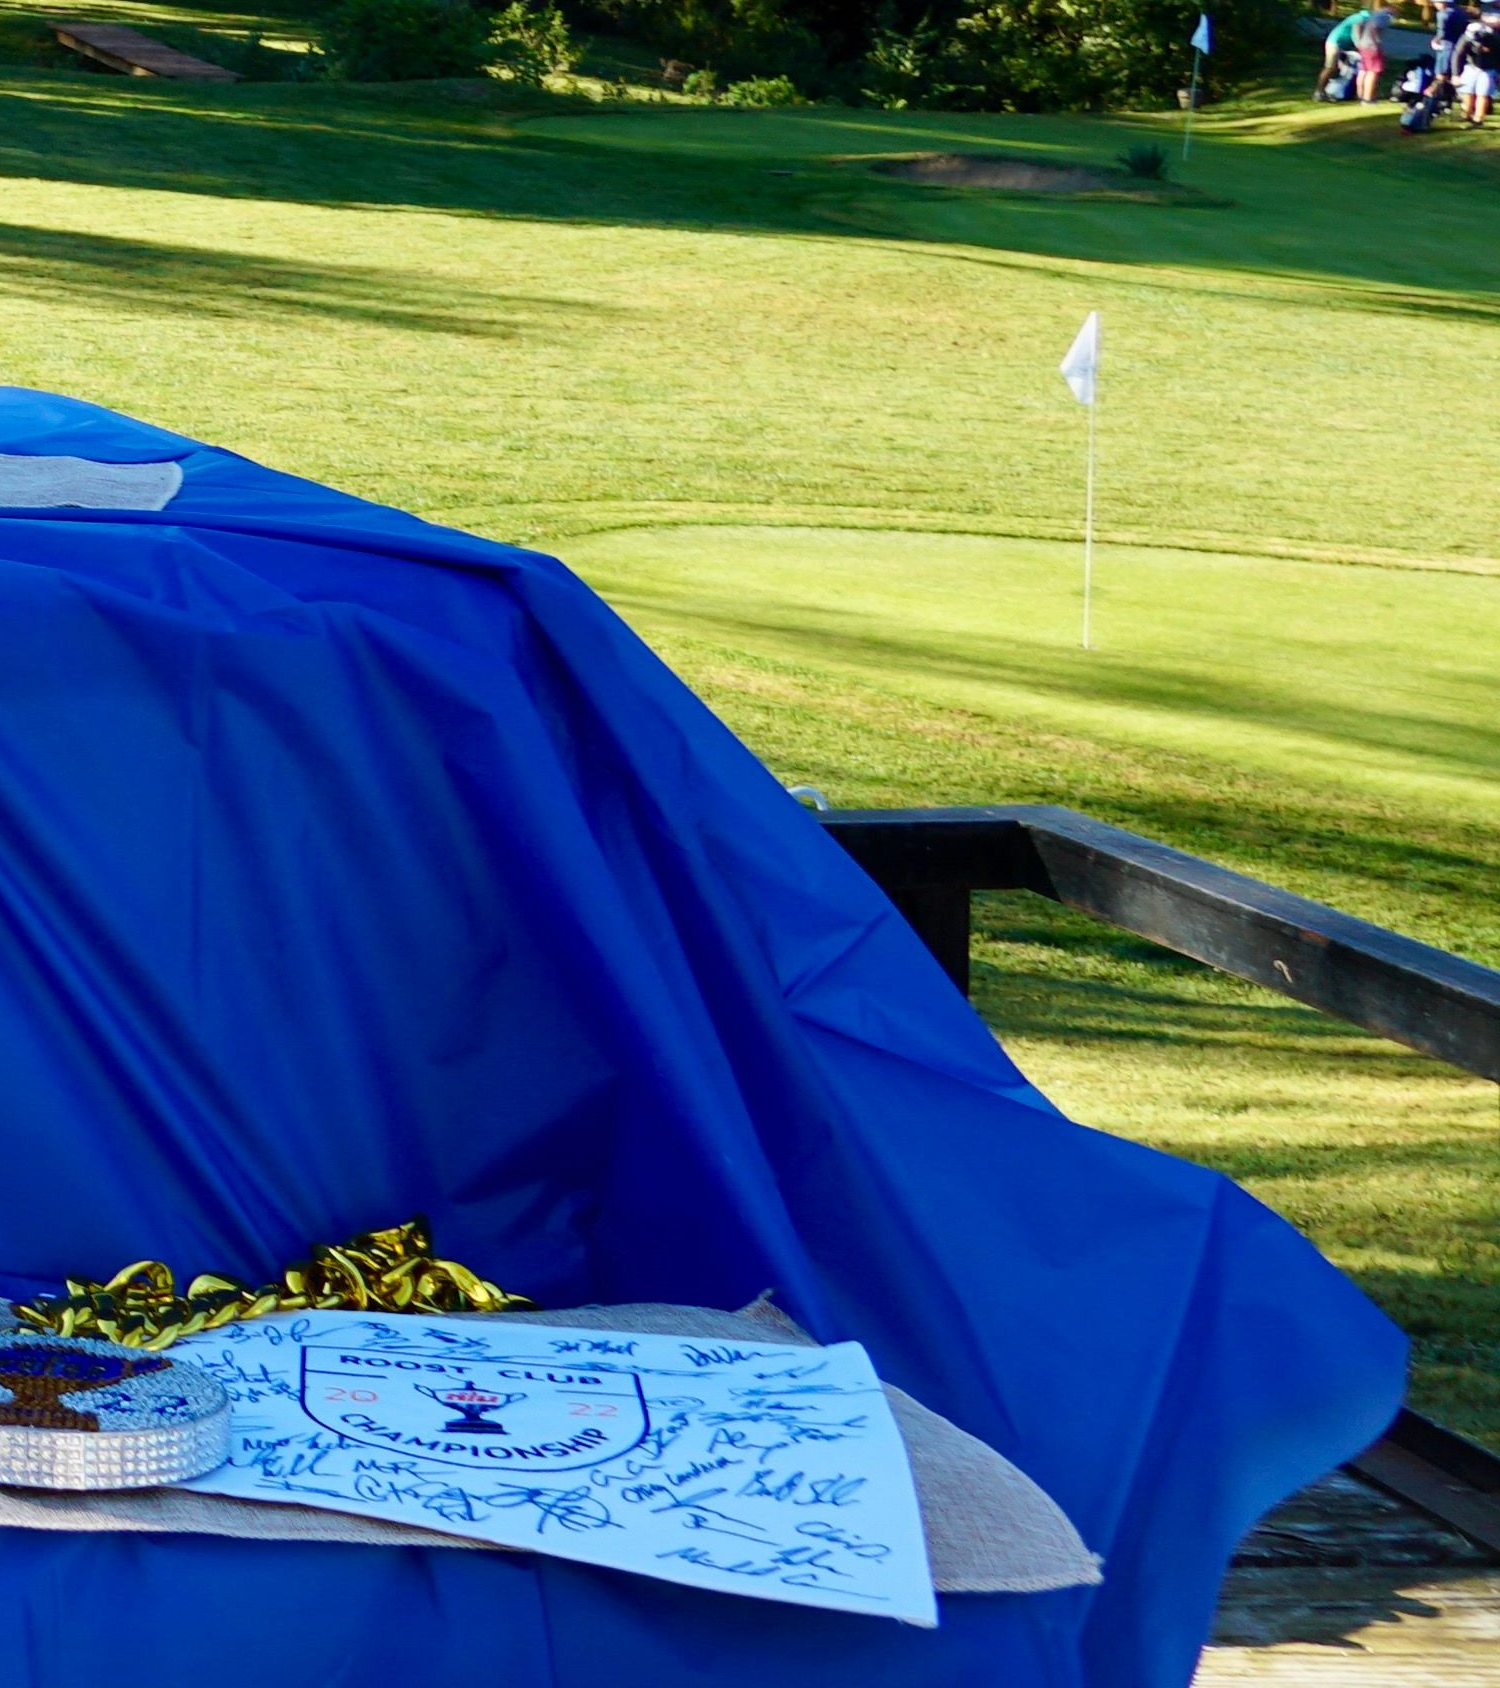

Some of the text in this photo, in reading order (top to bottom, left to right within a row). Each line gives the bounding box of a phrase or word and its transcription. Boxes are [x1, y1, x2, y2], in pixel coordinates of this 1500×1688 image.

[338, 1353, 603, 1385] ROOST CLUB
[324, 1387, 379, 1402] 20
[566, 1402, 619, 1417] 22
[339, 1413, 609, 1460] CHAMPIONSHIP
